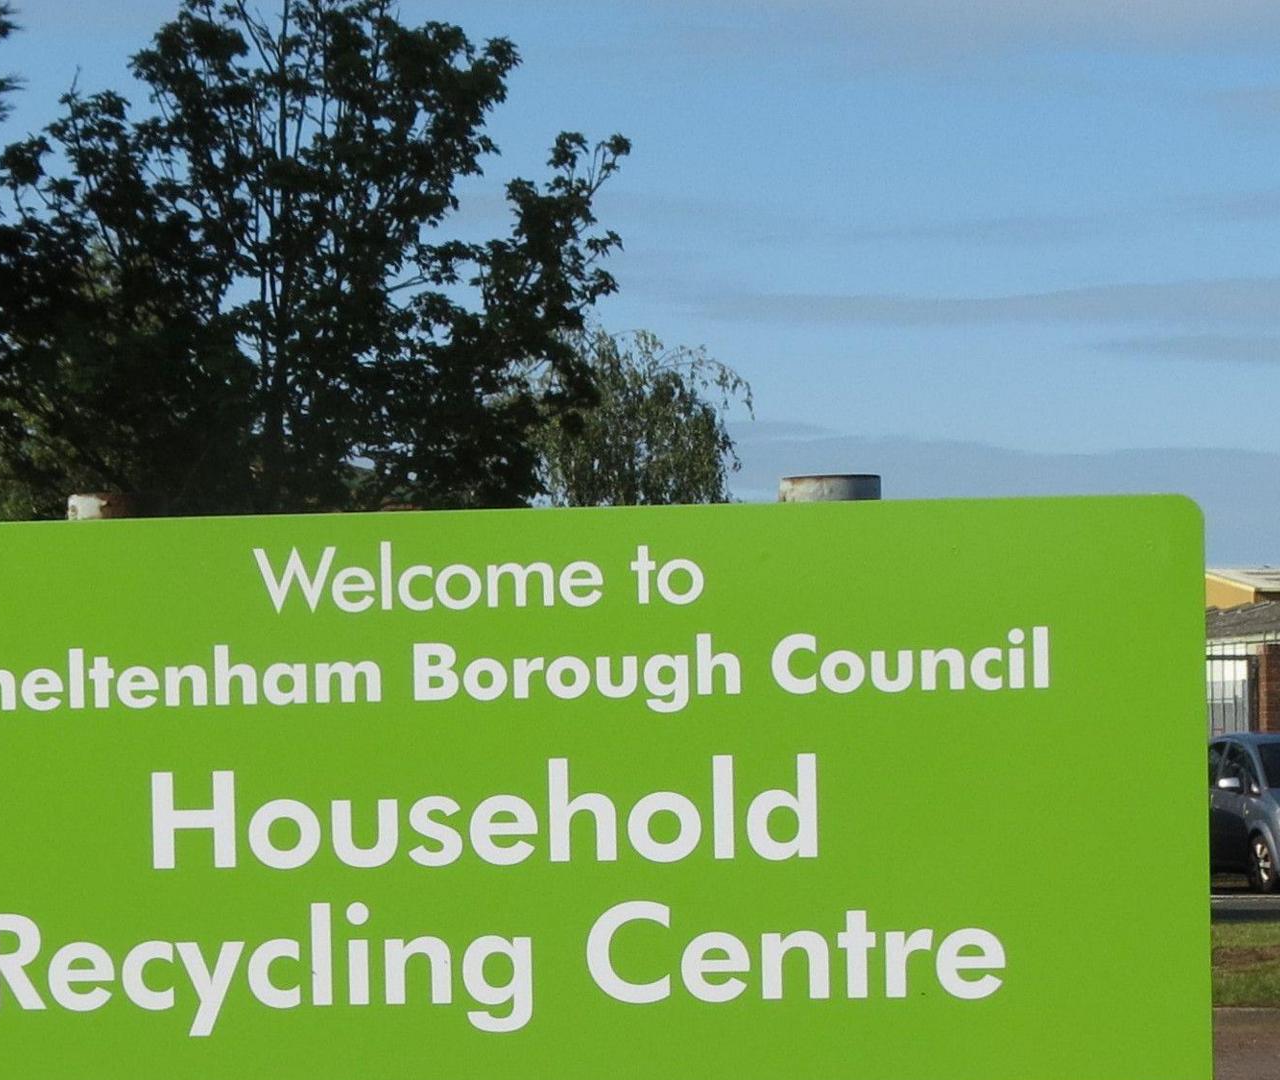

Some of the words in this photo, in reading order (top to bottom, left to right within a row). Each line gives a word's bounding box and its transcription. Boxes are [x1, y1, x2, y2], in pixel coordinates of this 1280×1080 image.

[252, 540, 604, 613] Welcome
[630, 544, 705, 605] to
[412, 641, 742, 713] Borough
[771, 626, 1050, 695] Council
[151, 752, 819, 870] Household
[586, 900, 1006, 1004] Centre
